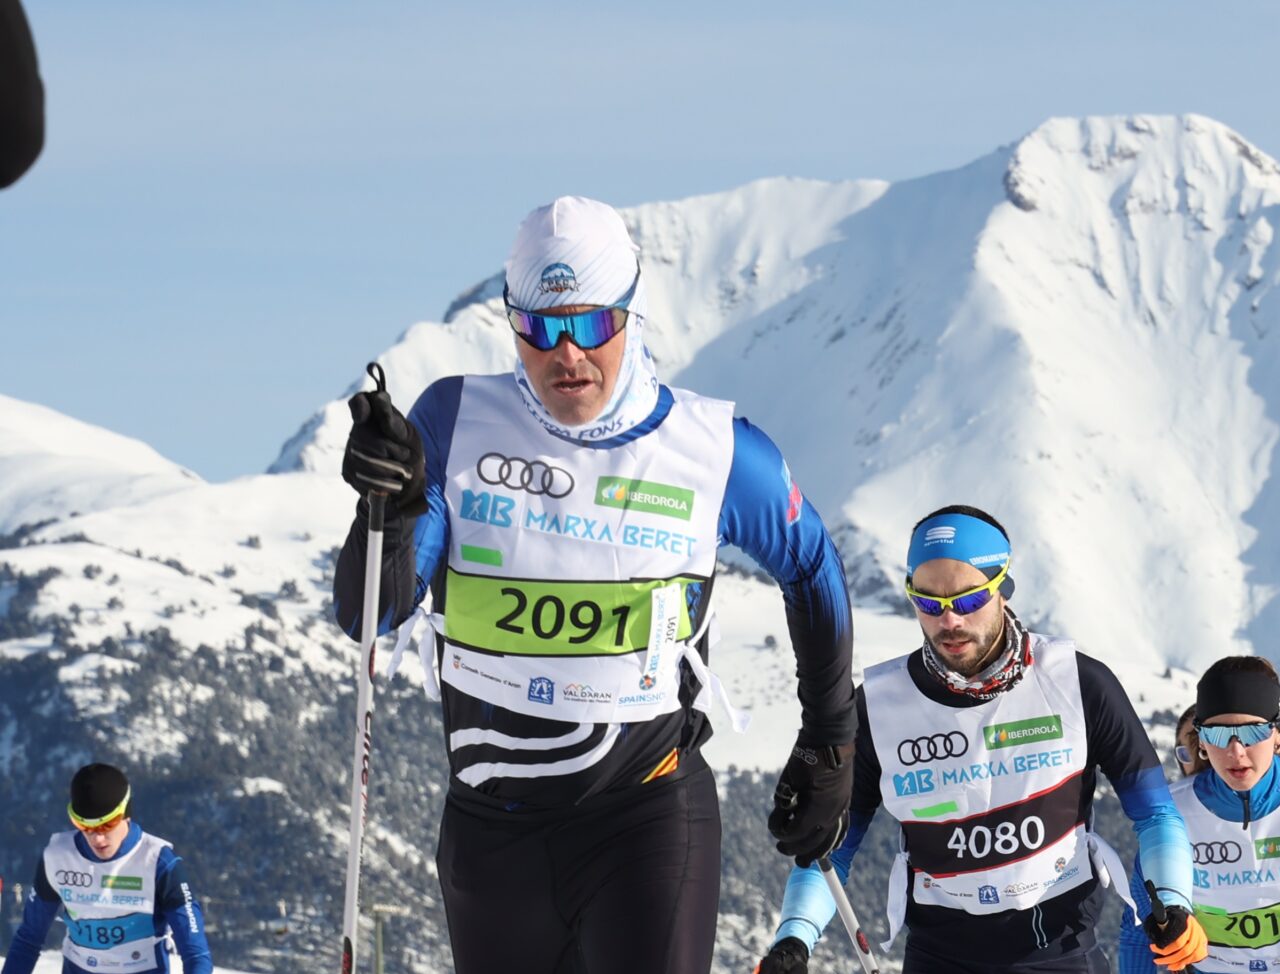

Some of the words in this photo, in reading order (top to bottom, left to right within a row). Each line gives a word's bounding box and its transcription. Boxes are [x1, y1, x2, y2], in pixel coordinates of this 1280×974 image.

[577, 415, 625, 440] FONS
[627, 490, 689, 513] IBERDROLA
[525, 508, 613, 543] MARXA
[622, 525, 698, 559] BERET
[495, 587, 631, 647] 2091
[617, 692, 667, 706] SPAINSNO
[1007, 724, 1059, 741] IBERDROLA
[942, 761, 1009, 787] MARXA
[1013, 748, 1073, 774] BERET
[947, 815, 1046, 859] 4080
[1217, 868, 1275, 887] MARXA
